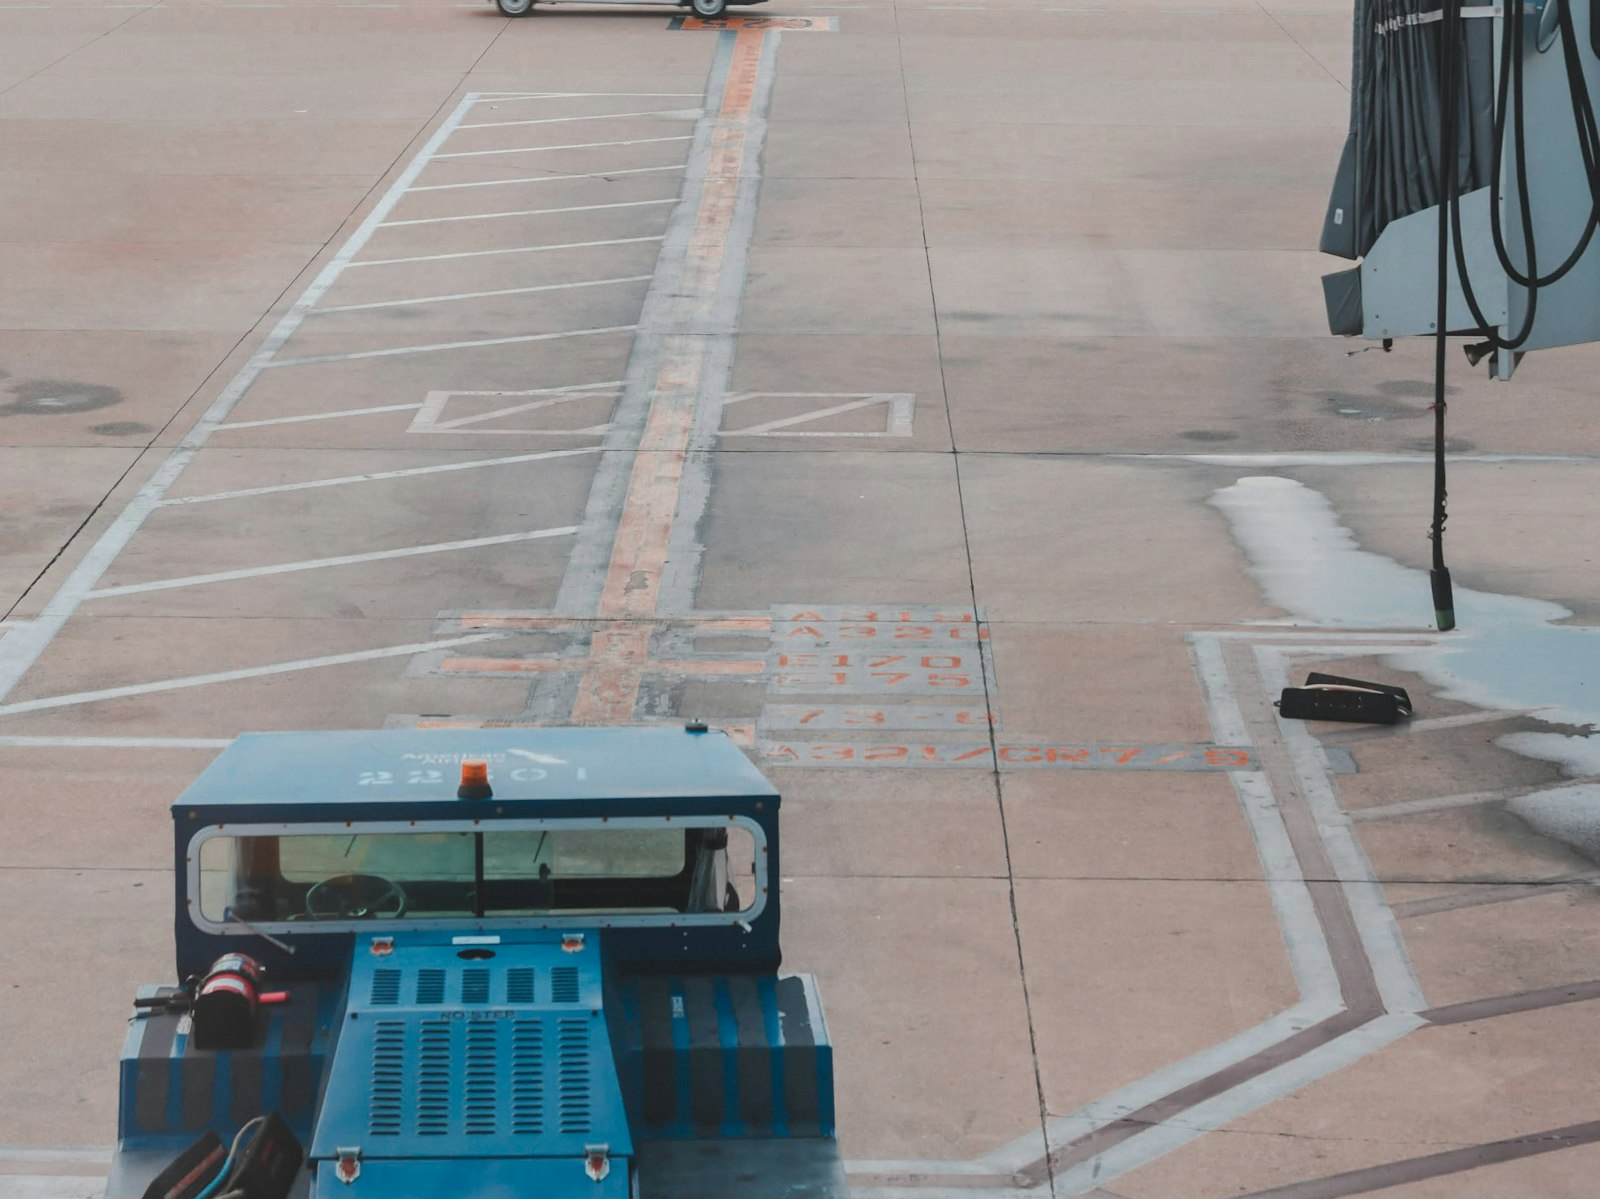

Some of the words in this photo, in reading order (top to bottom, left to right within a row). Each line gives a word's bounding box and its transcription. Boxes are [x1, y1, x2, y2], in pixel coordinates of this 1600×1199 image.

[786, 626, 990, 640] A320
[779, 655, 962, 669] E170
[358, 766, 587, 785] 2201
[440, 1011, 465, 1020] NO
[471, 1010, 516, 1020] STEP
